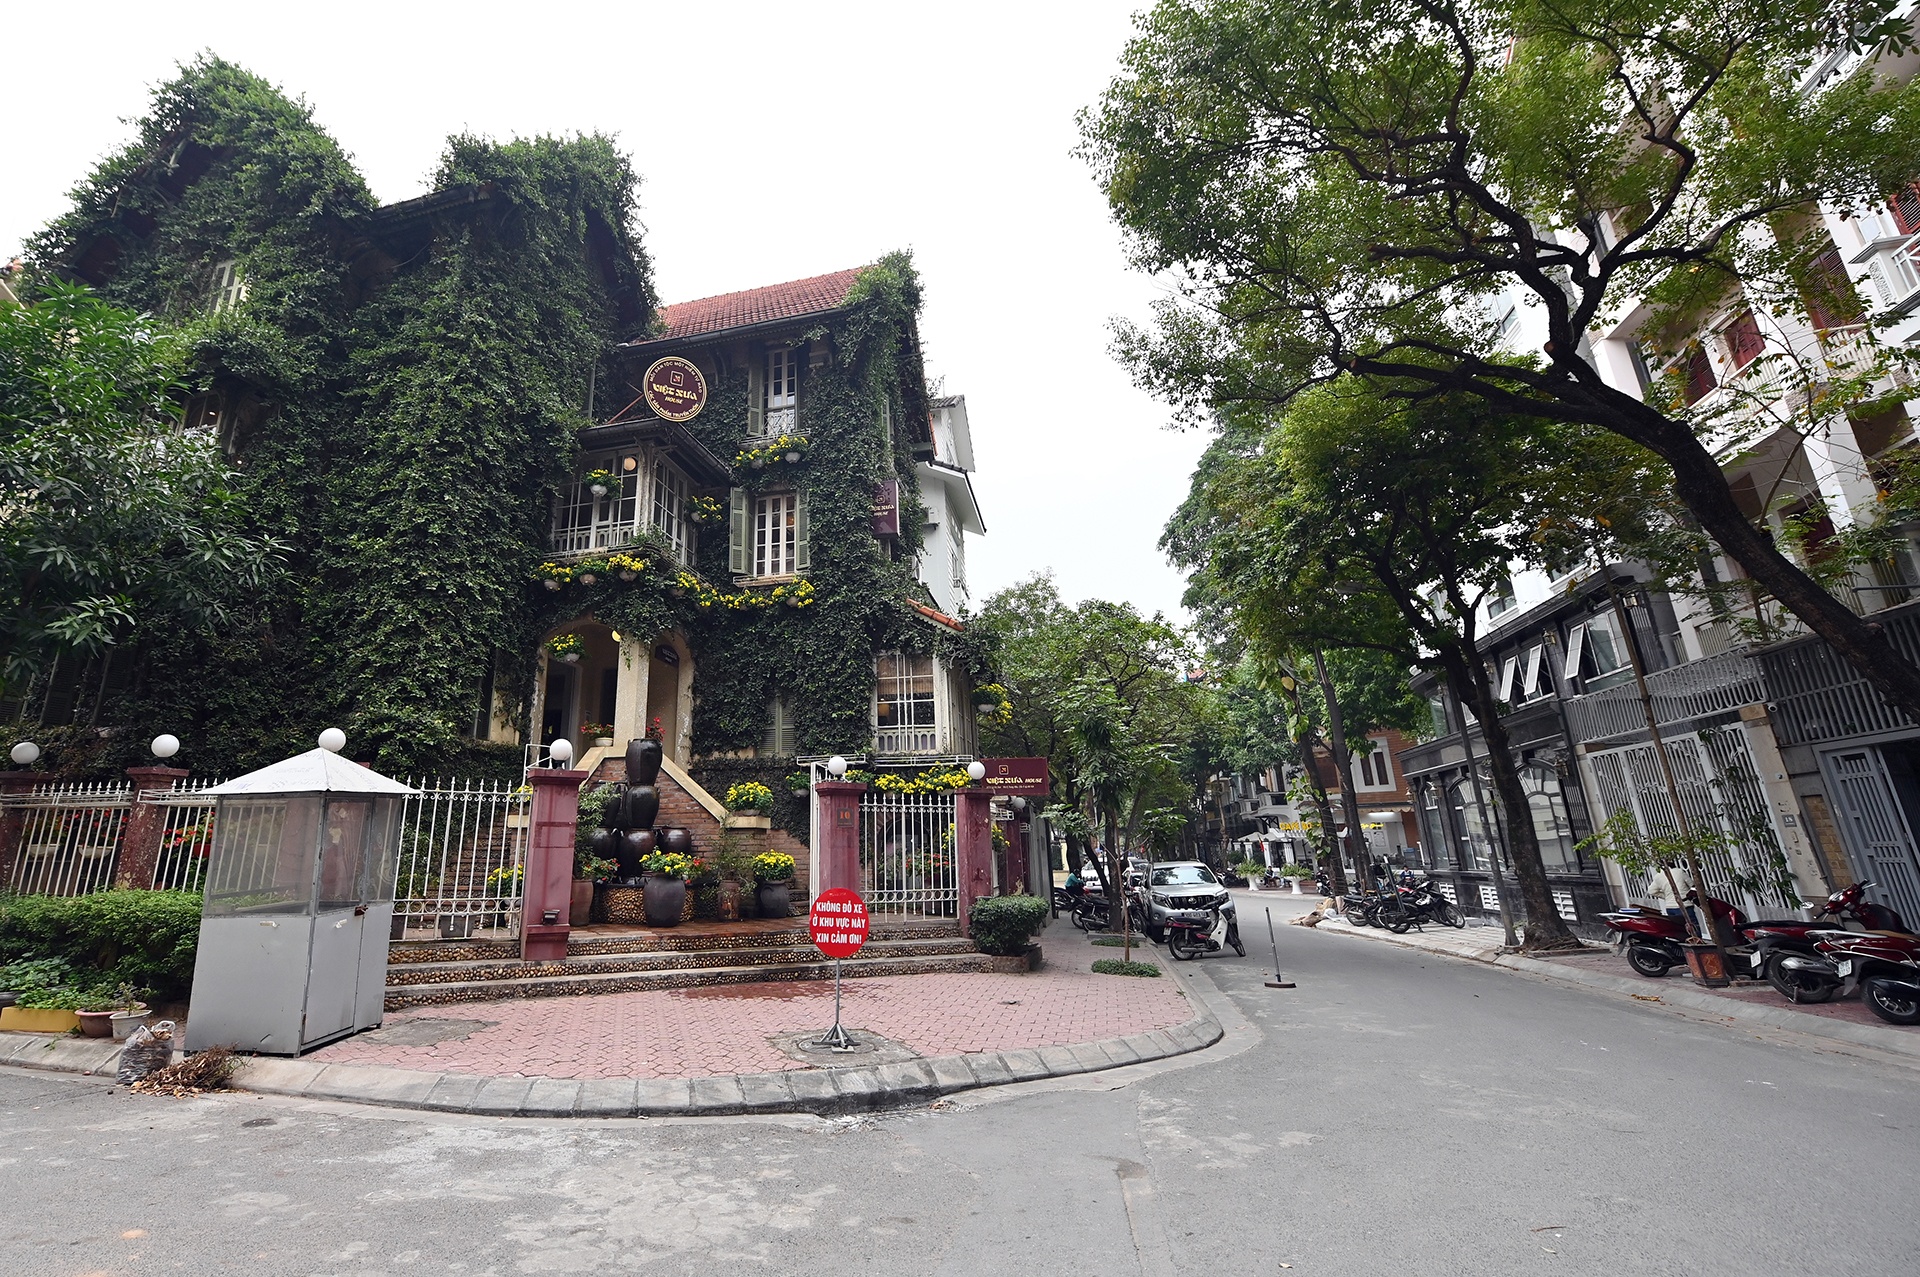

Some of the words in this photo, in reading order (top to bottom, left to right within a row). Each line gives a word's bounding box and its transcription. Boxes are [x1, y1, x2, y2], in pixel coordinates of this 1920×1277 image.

[652, 383, 675, 395] VIỆT
[675, 388, 698, 401] XƯA
[986, 776, 1004, 785] VIỆT
[1005, 776, 1023, 784] XƯA
[840, 811, 850, 819] 10
[816, 900, 841, 913] KHÔNG
[853, 903, 863, 914] XE
[812, 913, 819, 927] Ở
[819, 917, 834, 927] KHU
[835, 917, 850, 929] VỰC
[851, 917, 866, 929] NÀY
[816, 932, 830, 943] XIN
[830, 930, 848, 944] CẢM
[849, 933, 862, 945] ƠN!
